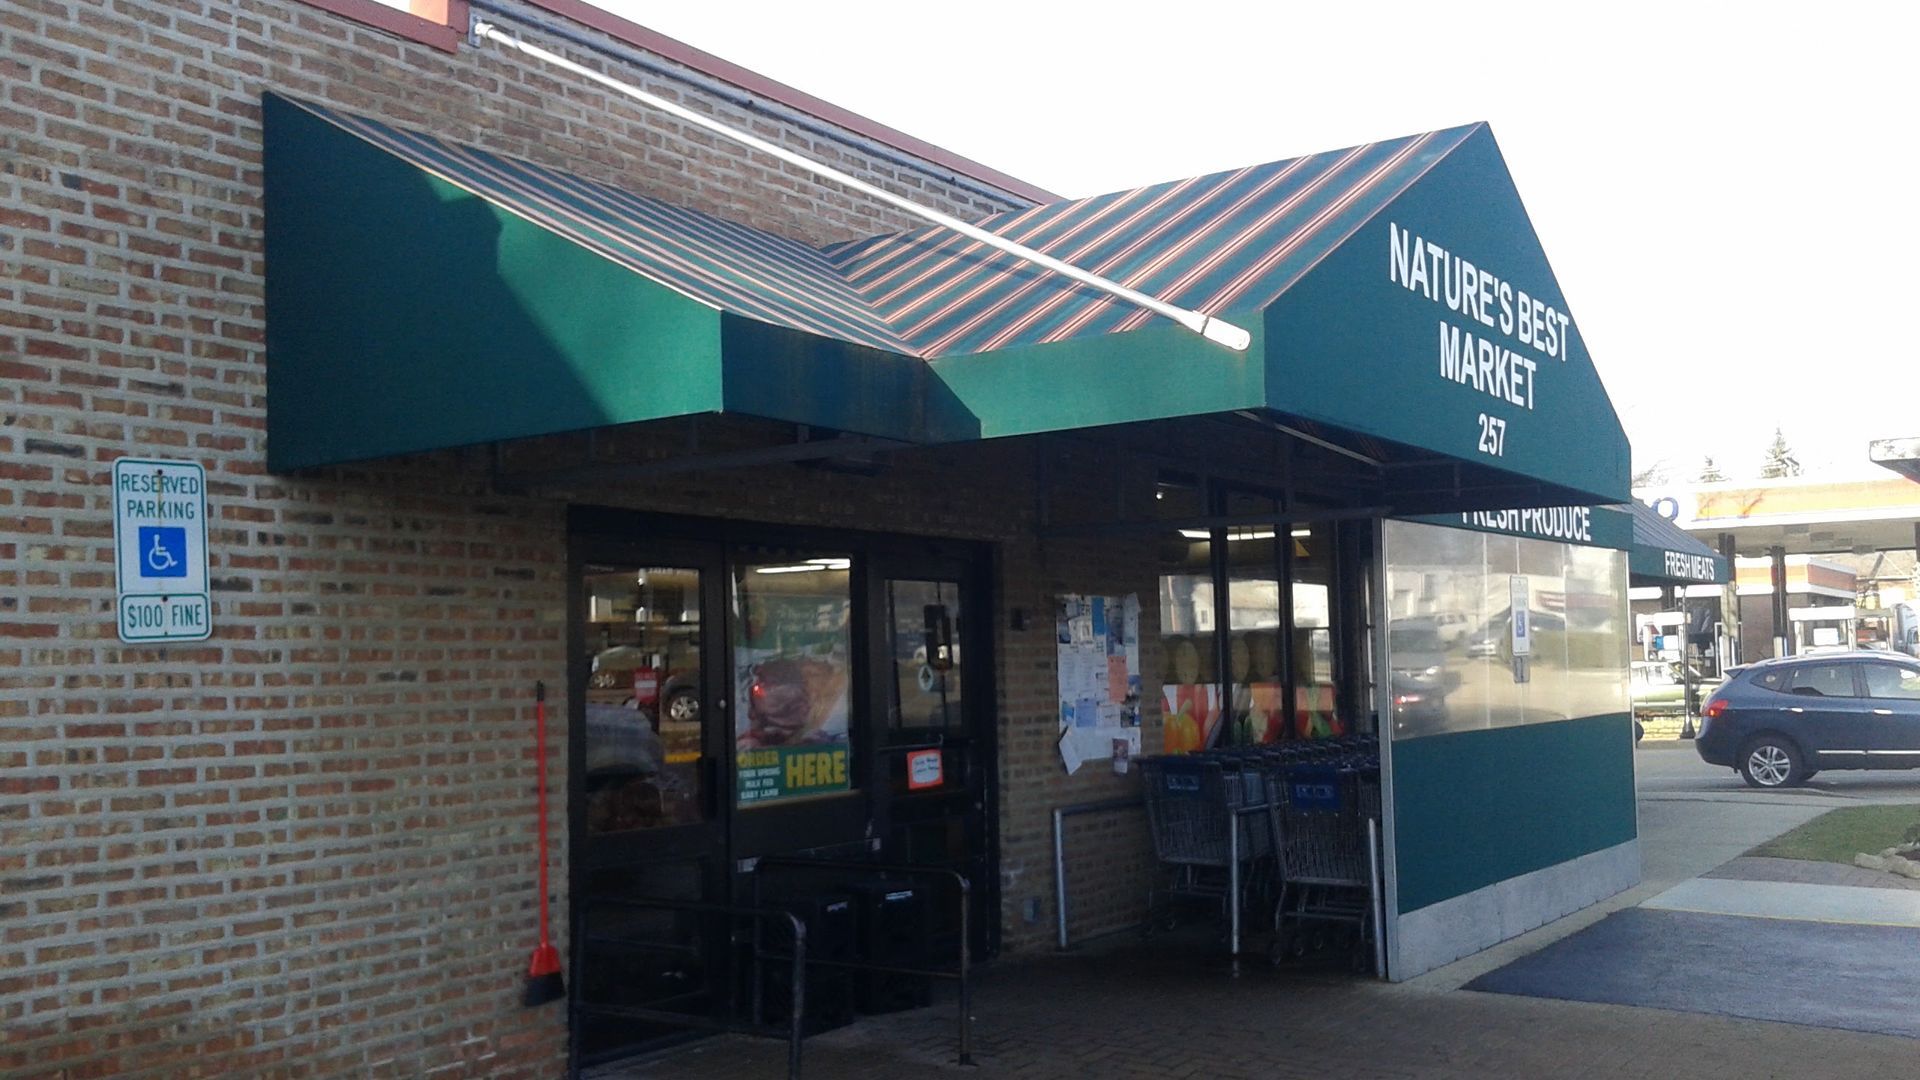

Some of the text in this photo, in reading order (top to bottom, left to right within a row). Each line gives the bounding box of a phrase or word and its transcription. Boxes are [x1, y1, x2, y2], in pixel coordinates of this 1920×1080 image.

[1390, 222, 1569, 362] NATURE'S BEST
[1439, 320, 1536, 410] MARKET
[1478, 413, 1506, 456] 257
[120, 473, 199, 494] RESERVED
[127, 499, 195, 520] PARKING
[1522, 505, 1592, 541] PRODUCE
[1664, 550, 1715, 581] FRESH MEATS
[127, 604, 203, 628] $100 FINE
[786, 751, 847, 787] HERE
